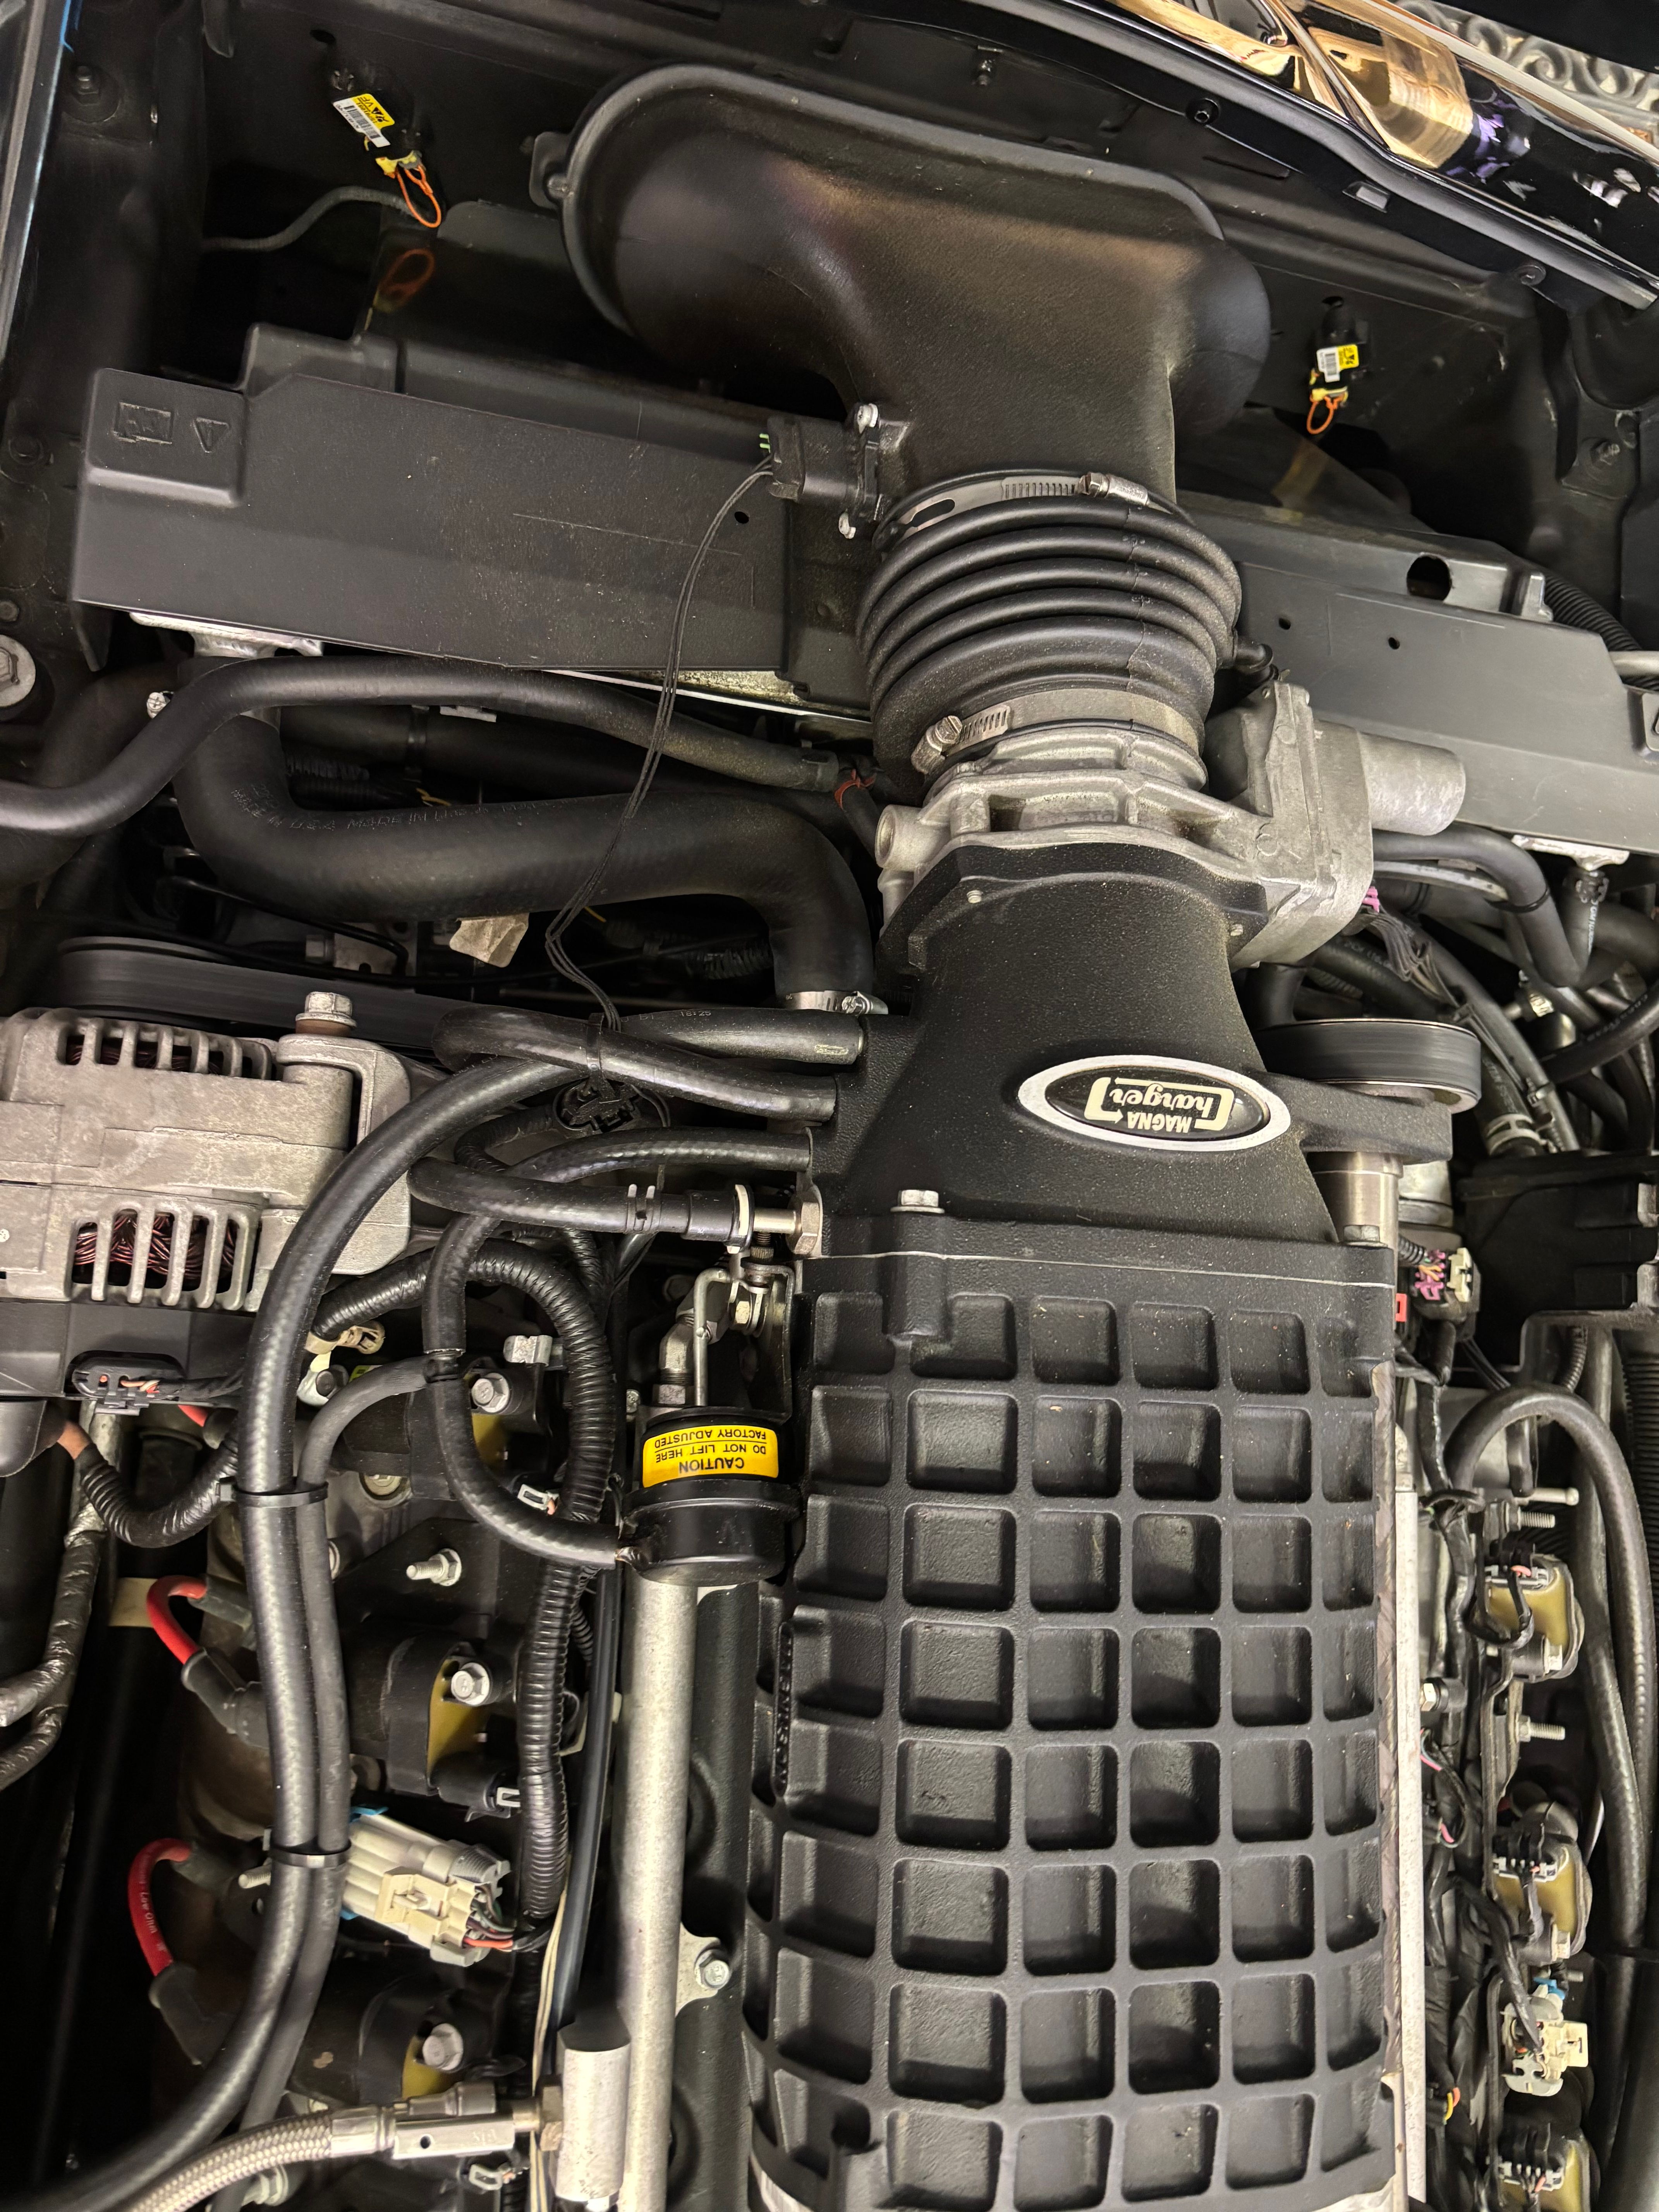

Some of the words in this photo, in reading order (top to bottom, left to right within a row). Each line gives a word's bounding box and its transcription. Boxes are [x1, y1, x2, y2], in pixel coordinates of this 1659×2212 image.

[1127, 1111, 1192, 1133] MAGNA
[654, 1429, 712, 1448] ADJUSTED
[717, 1429, 766, 1439] FACTORY
[690, 1444, 714, 1455] LIFT
[723, 1444, 746, 1453] NOT
[753, 1445, 766, 1455] DO
[656, 1448, 682, 1463] HERE
[679, 1457, 744, 1474] CAUTION
